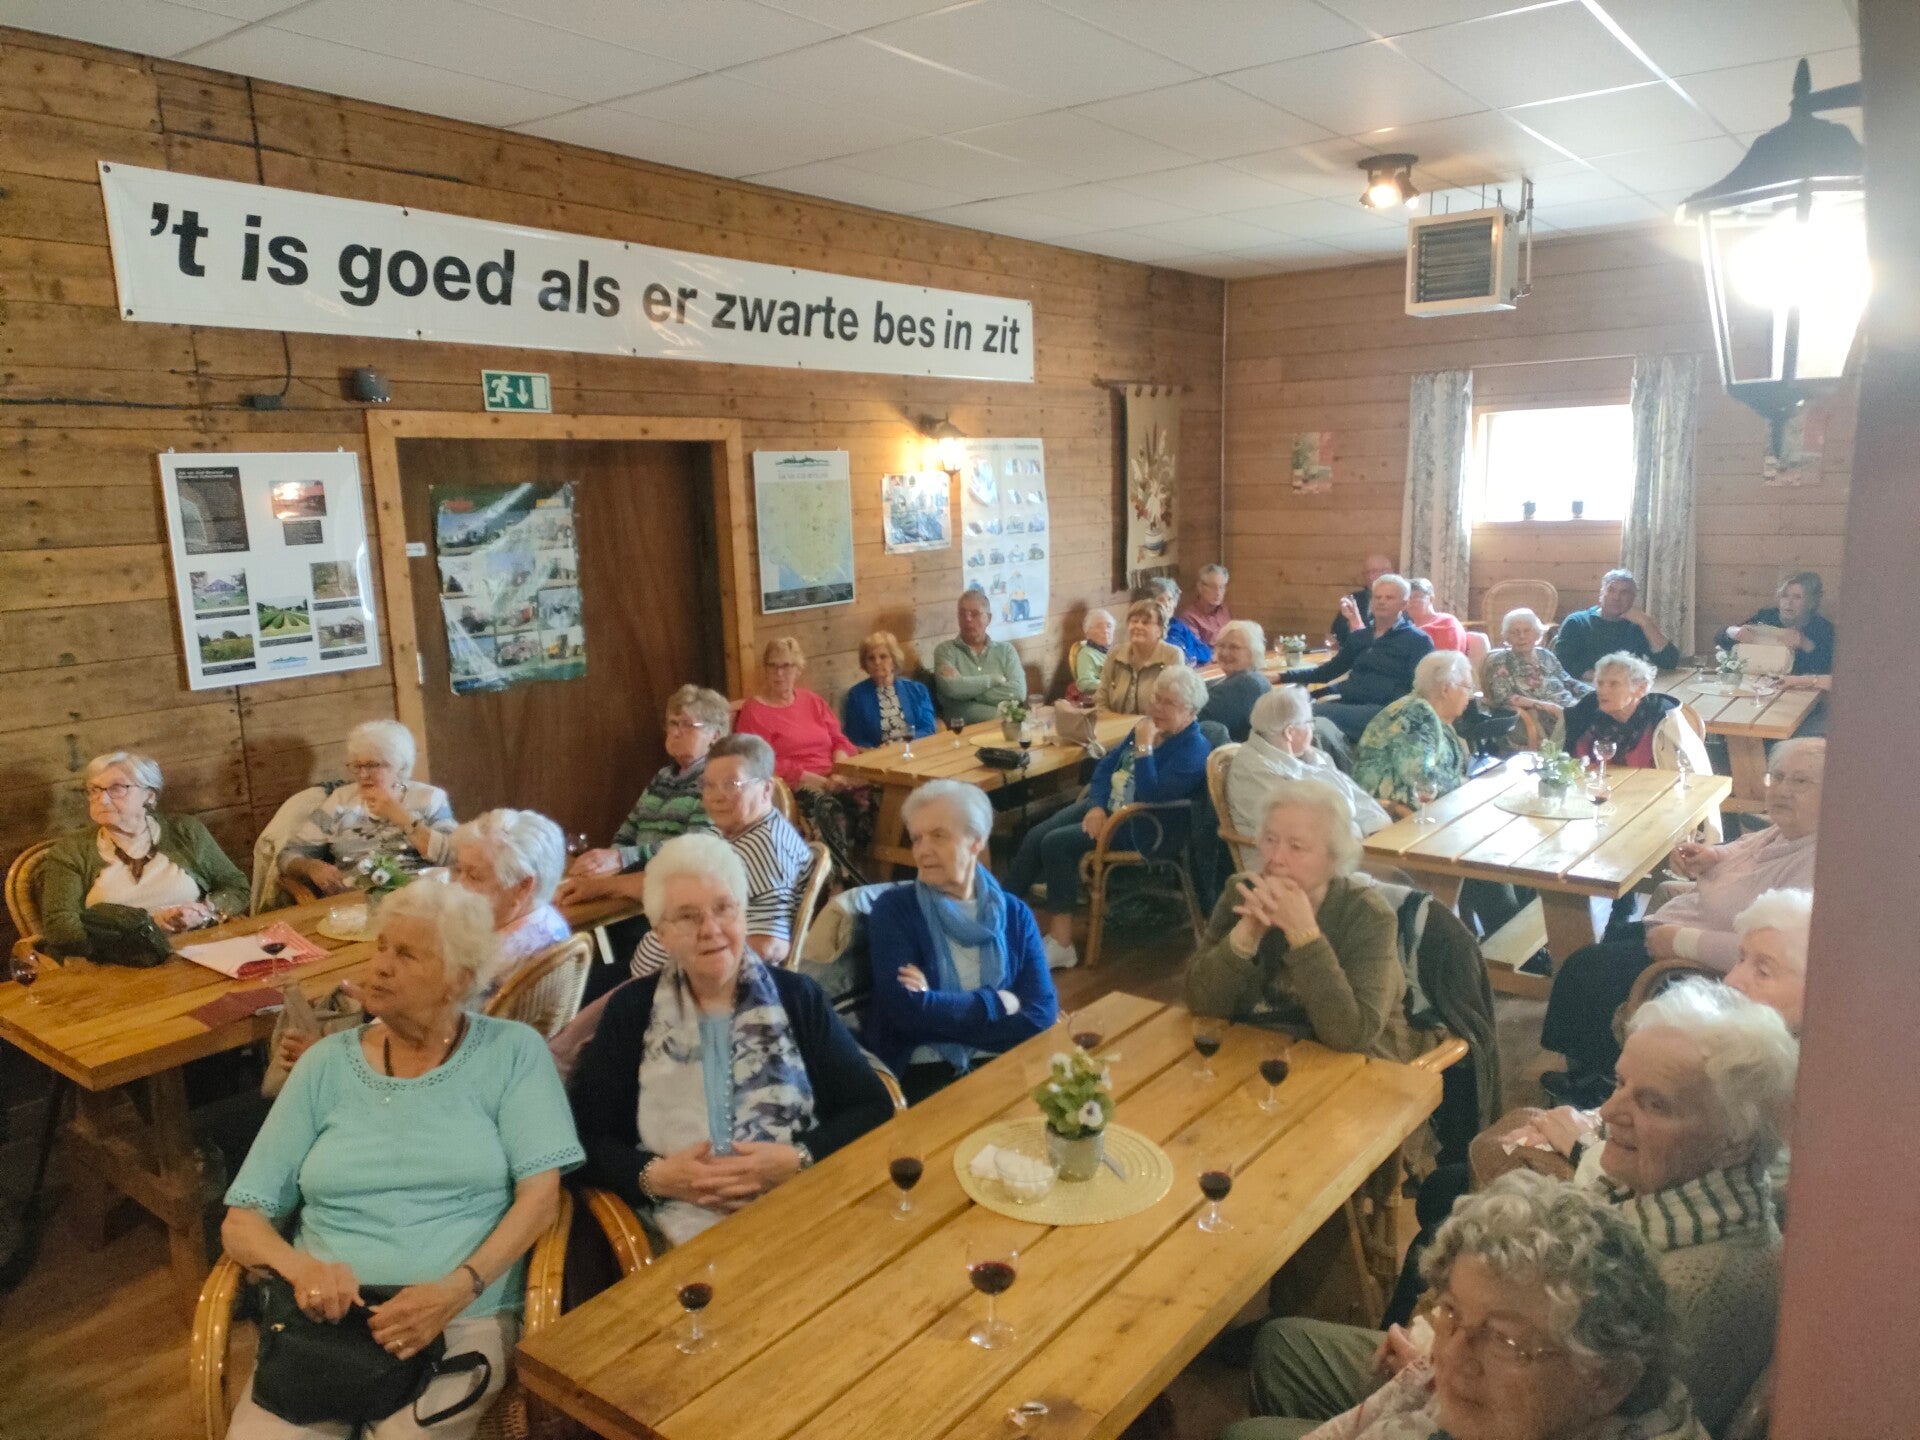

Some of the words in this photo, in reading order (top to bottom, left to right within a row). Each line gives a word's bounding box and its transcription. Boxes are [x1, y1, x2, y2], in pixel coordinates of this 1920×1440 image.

[241, 215, 309, 286] is
[338, 249, 515, 307] goed
[537, 259, 621, 318] als
[642, 282, 698, 324] er
[711, 292, 859, 341] zwarte
[873, 300, 935, 348] bes
[944, 309, 971, 351] in
[983, 315, 1019, 354] zit
